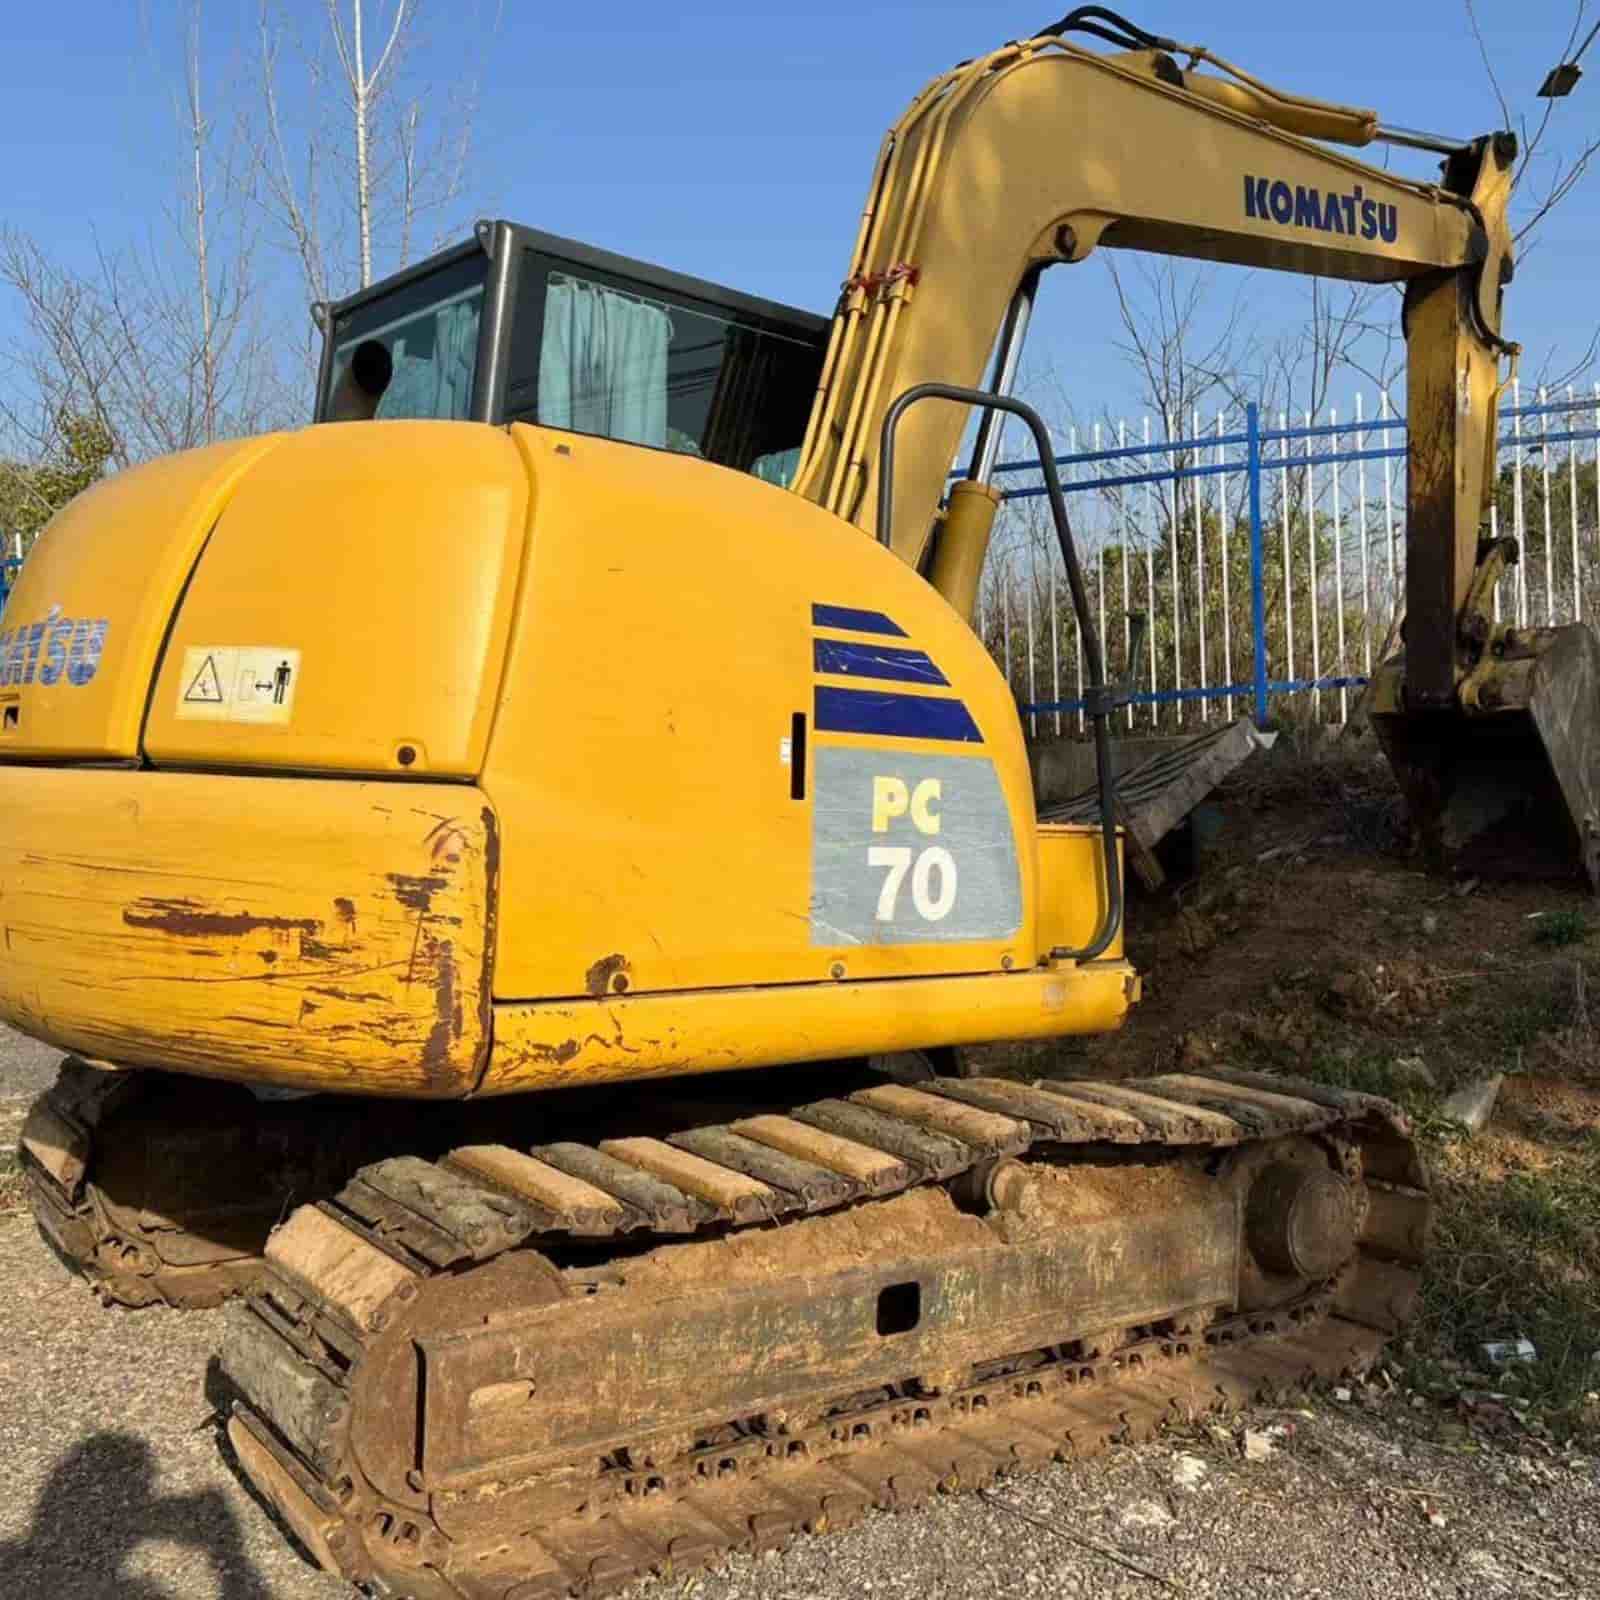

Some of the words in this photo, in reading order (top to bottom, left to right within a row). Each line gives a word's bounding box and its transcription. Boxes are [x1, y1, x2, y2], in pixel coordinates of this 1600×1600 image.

[1244, 175, 1397, 243] KOMATSU
[872, 775, 942, 835] PC
[867, 846, 957, 921] 70
